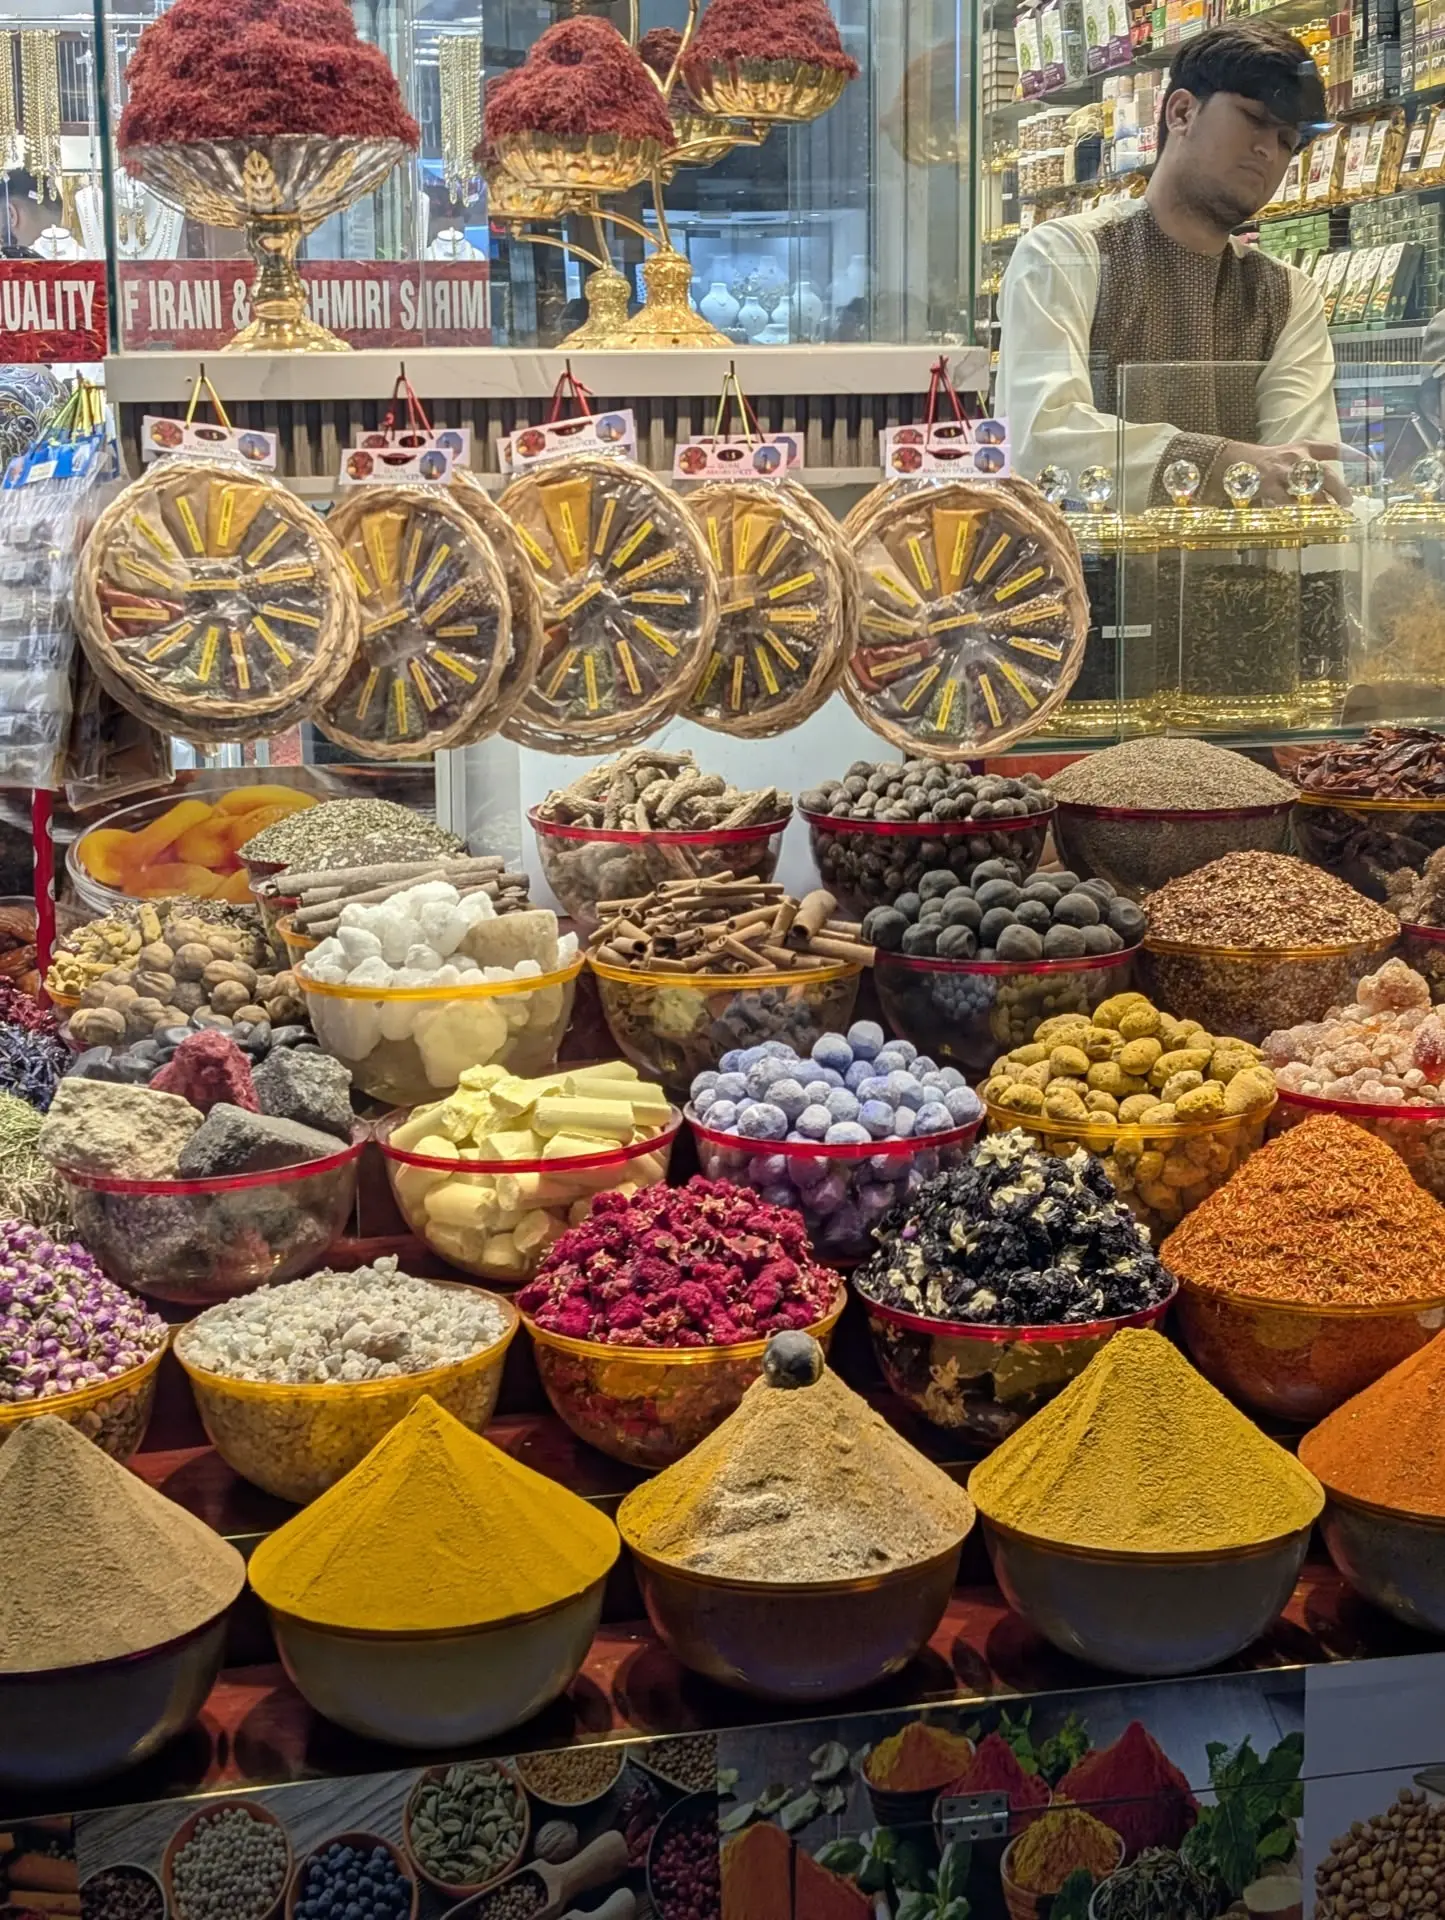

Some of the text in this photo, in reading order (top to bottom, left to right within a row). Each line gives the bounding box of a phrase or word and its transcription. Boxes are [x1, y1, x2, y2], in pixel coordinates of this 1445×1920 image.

[0, 280, 95, 331] UALITY
[119, 280, 139, 330] F
[149, 279, 222, 330] IRANI
[232, 279, 250, 330] &
[301, 279, 390, 329] HMIRI
